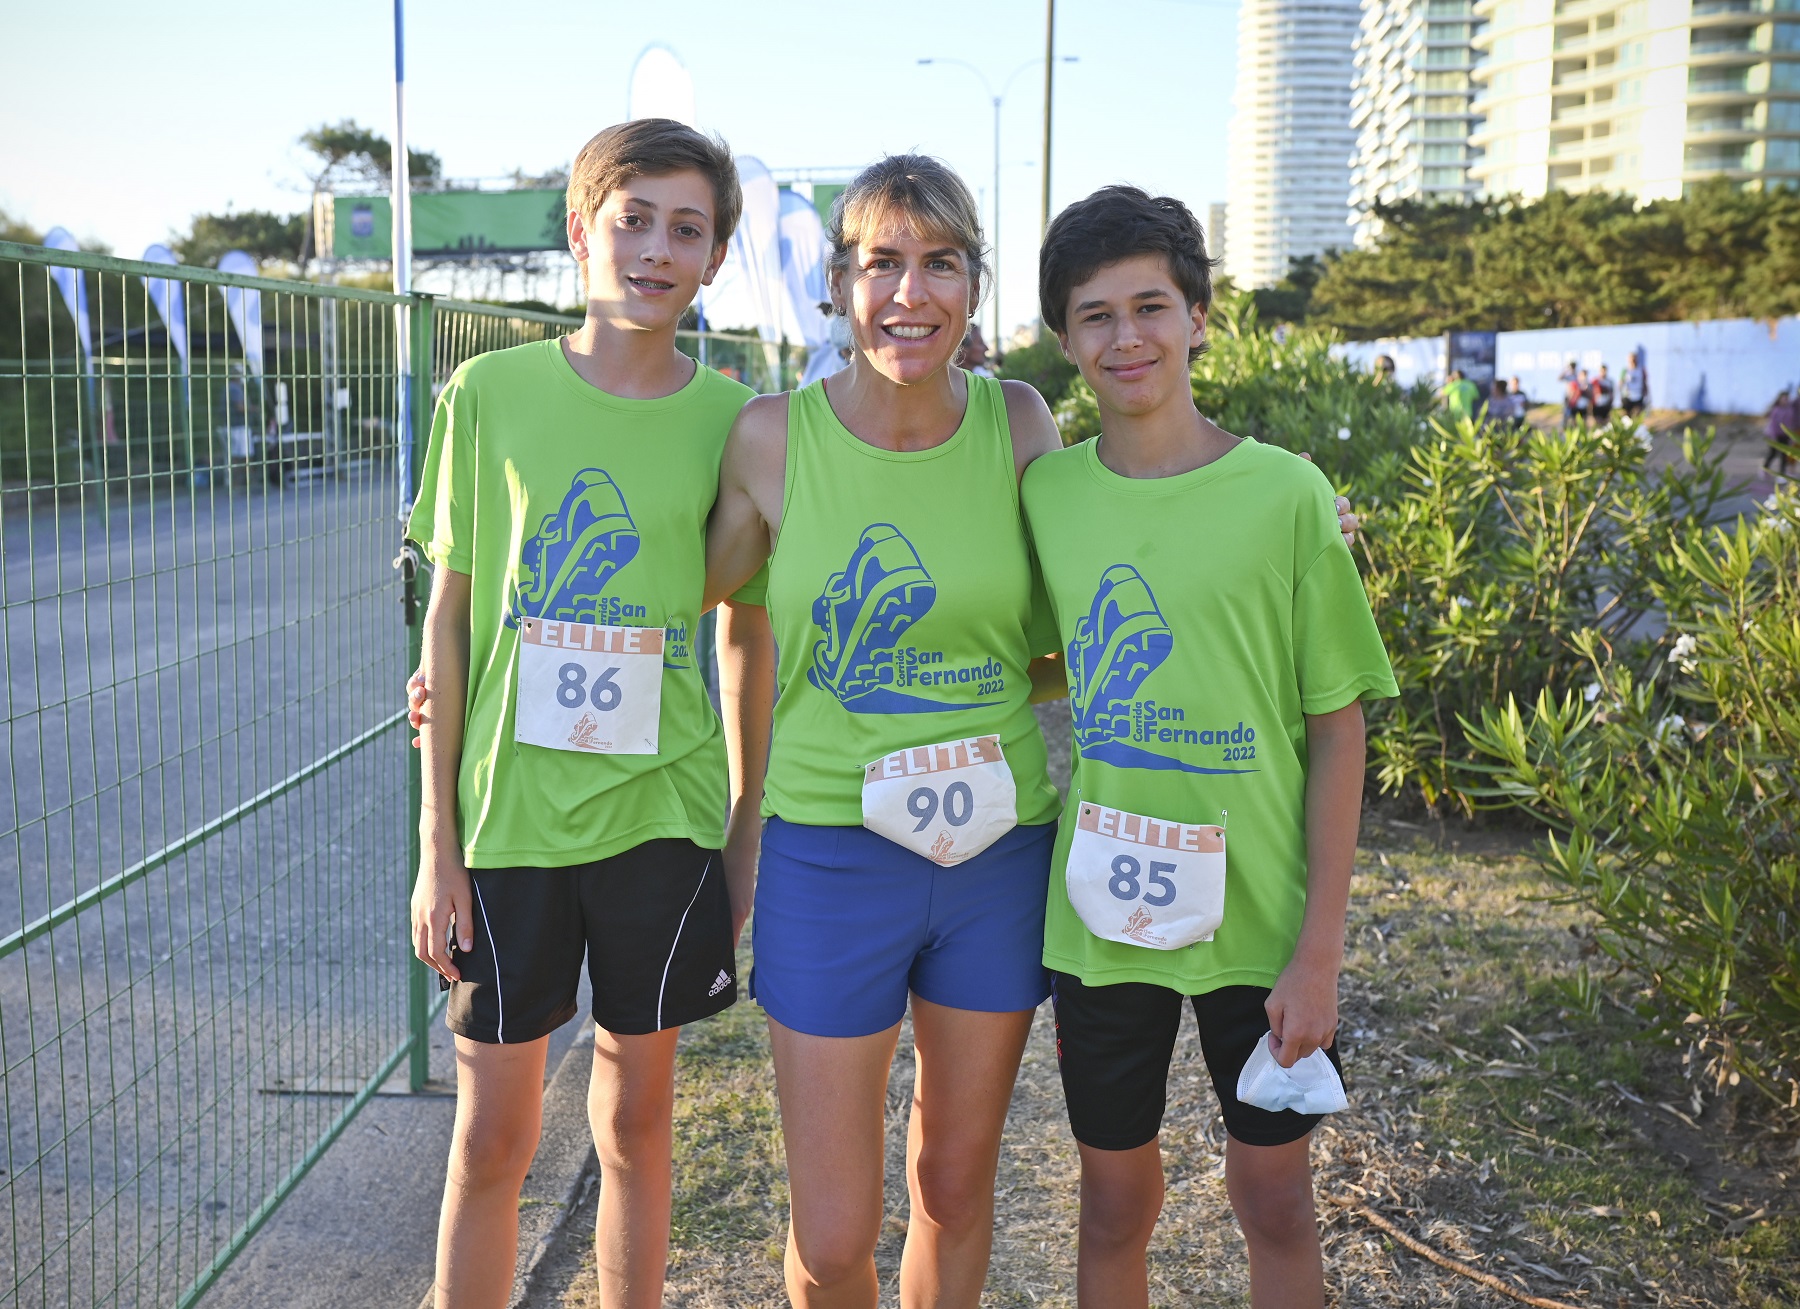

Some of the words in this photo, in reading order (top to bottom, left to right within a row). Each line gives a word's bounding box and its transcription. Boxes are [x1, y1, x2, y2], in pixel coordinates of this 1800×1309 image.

[598, 597, 608, 626] rrida
[608, 596, 646, 618] San
[541, 622, 643, 652] ELITE
[895, 648, 905, 687] Corrida
[905, 646, 943, 665] San
[906, 656, 1003, 687] Fernando
[556, 662, 622, 712] 86
[976, 678, 1004, 696] 2022
[1133, 701, 1143, 742] Corrida
[1143, 700, 1185, 721] San
[1143, 721, 1256, 745] Fernando
[882, 737, 985, 779] ELITE
[1222, 745, 1257, 762] 2022
[906, 781, 974, 834] 90
[1097, 806, 1201, 851] ELITE
[1108, 854, 1178, 907] 85
[709, 978, 731, 995] adidas
